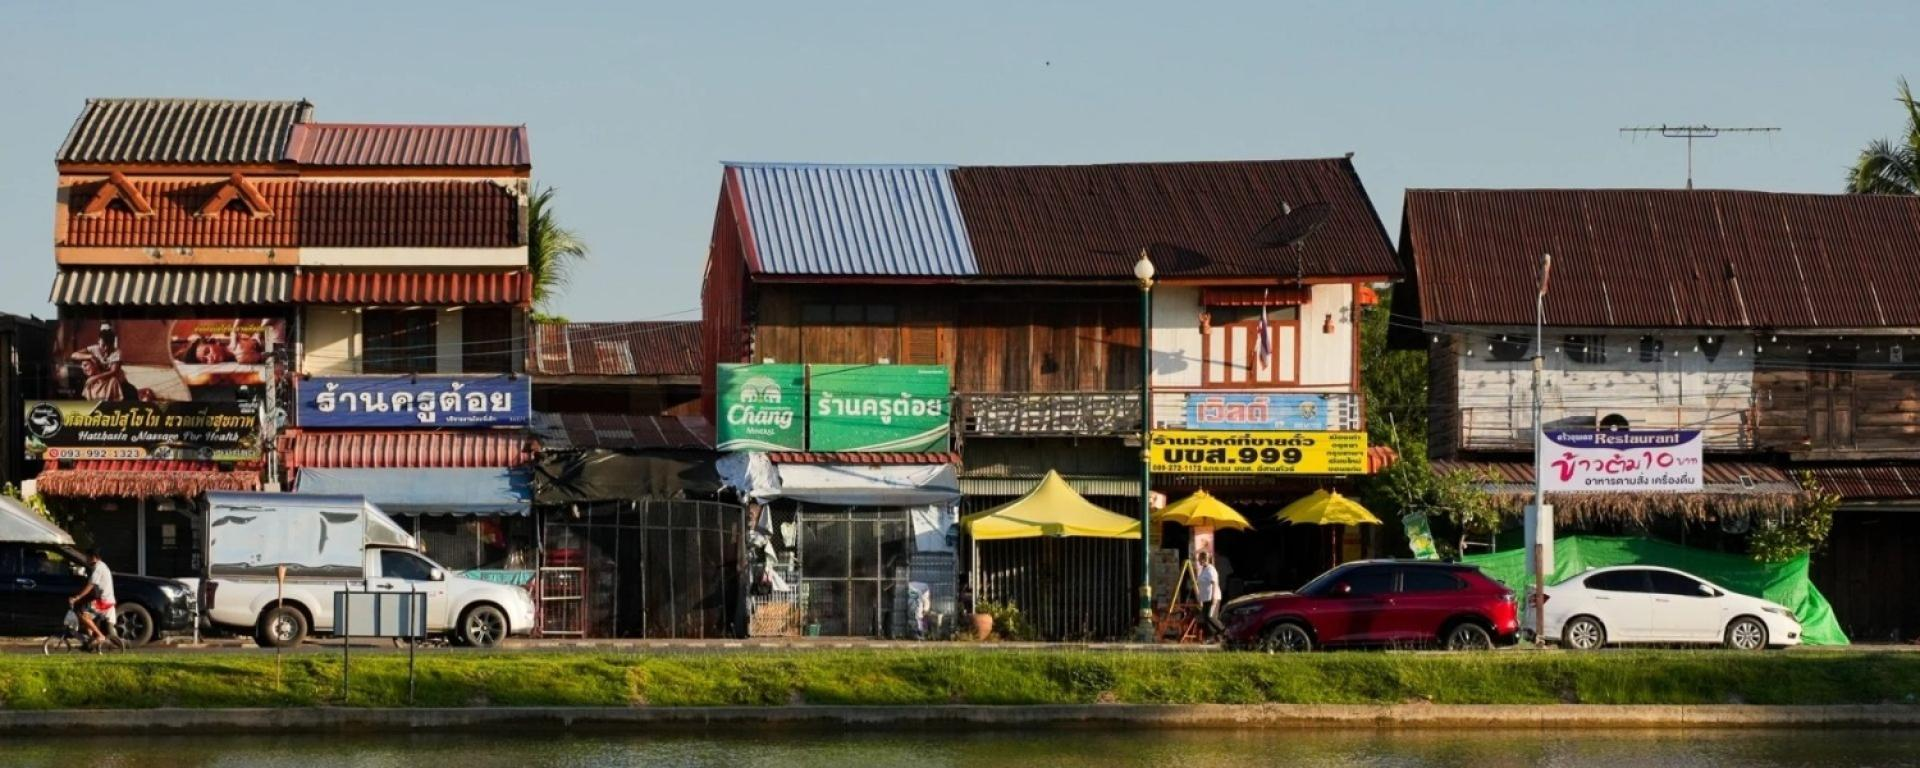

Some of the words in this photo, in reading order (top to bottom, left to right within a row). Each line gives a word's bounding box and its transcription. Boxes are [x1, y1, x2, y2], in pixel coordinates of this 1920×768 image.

[316, 382, 512, 423] ร้านครูต้อย
[818, 392, 942, 425] ร้านครูต้อย
[727, 404, 794, 430] Chang
[131, 431, 179, 444] Massage
[182, 431, 200, 441] For
[204, 431, 240, 442] Health
[1595, 433, 1680, 444] Restaurant
[60, 450, 81, 458] 093
[86, 450, 107, 458] 992
[113, 450, 140, 458] 1323
[1164, 447, 1303, 464] บขส.999
[1551, 452, 1640, 482] ข้าวต้ม
[1585, 474, 1649, 485] อาหารตามสั่ง
[1651, 472, 1695, 485] เครื่องดื่ม
